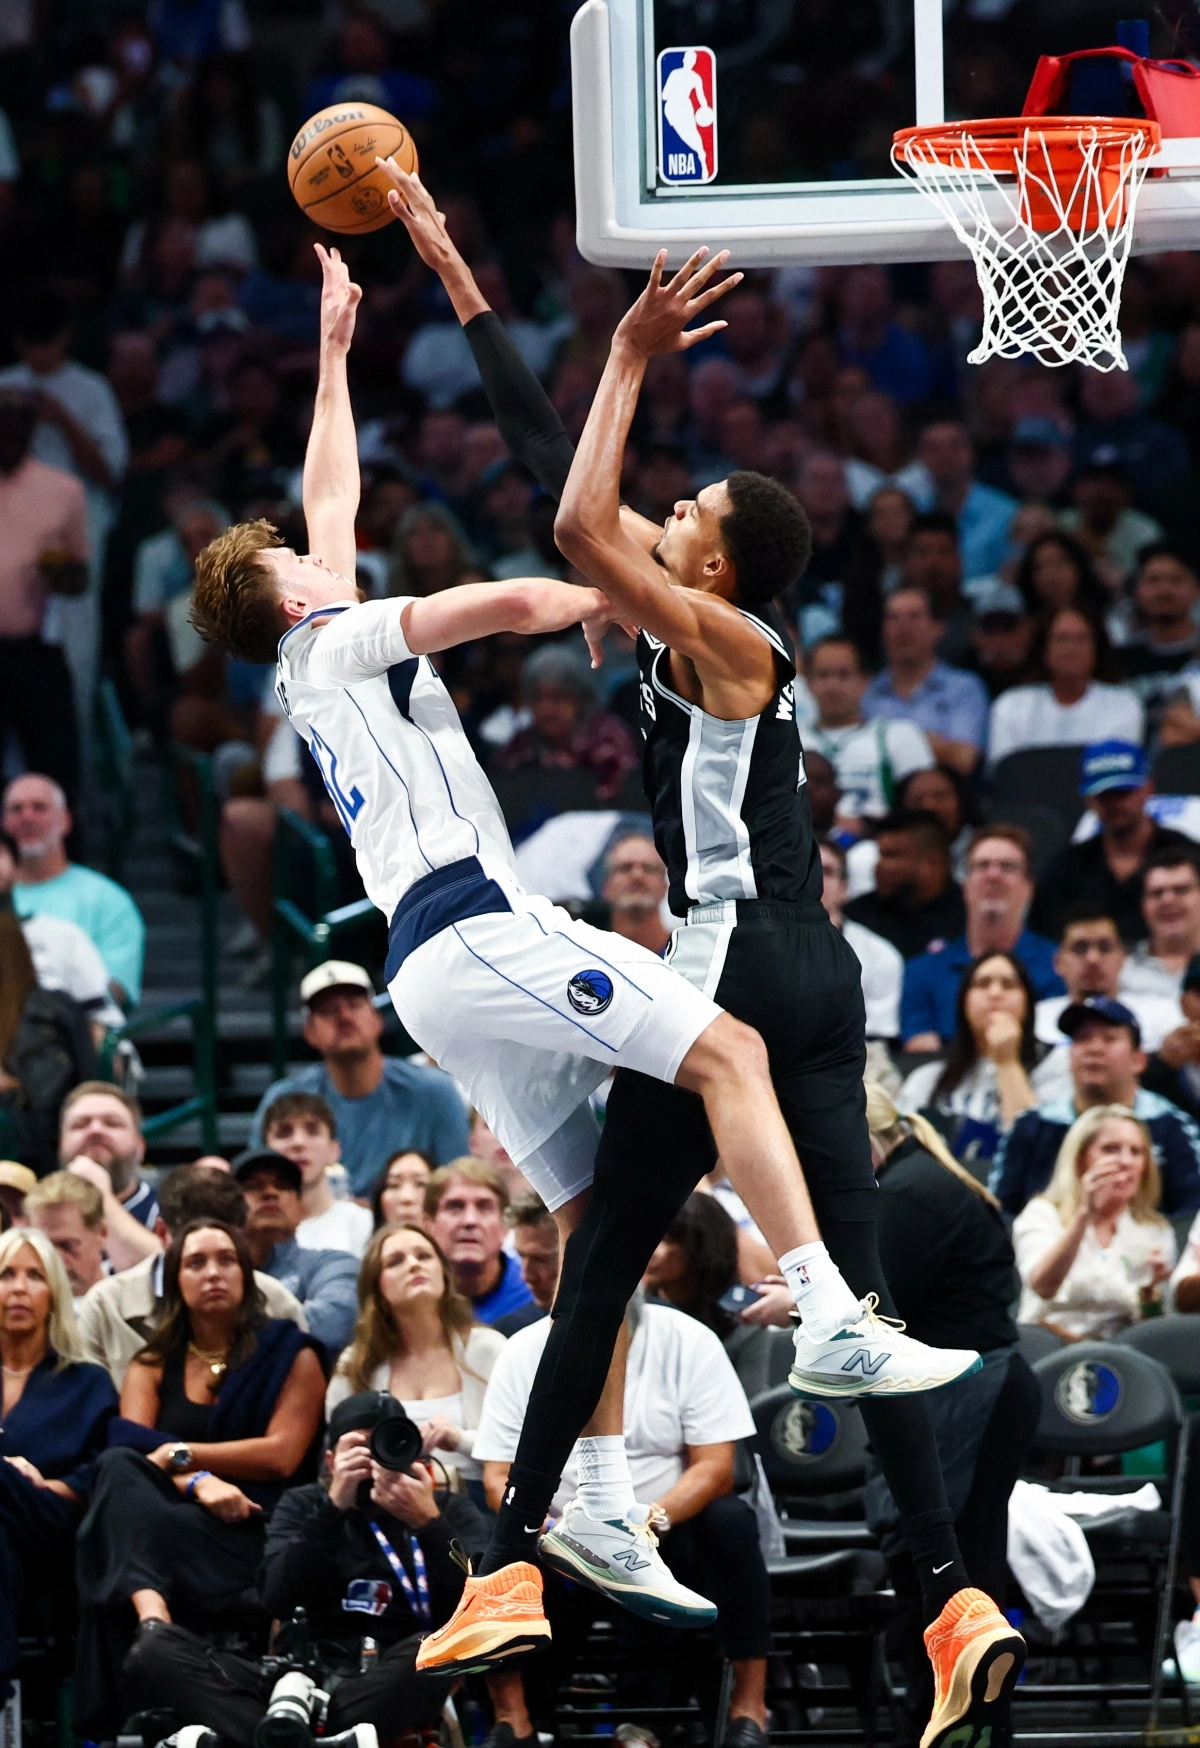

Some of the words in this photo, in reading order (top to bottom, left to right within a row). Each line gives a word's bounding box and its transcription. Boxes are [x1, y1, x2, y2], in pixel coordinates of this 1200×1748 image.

[291, 111, 365, 159] Wilson
[668, 153, 696, 176] NBA
[841, 1349, 892, 1375] N
[613, 1549, 652, 1572] N
